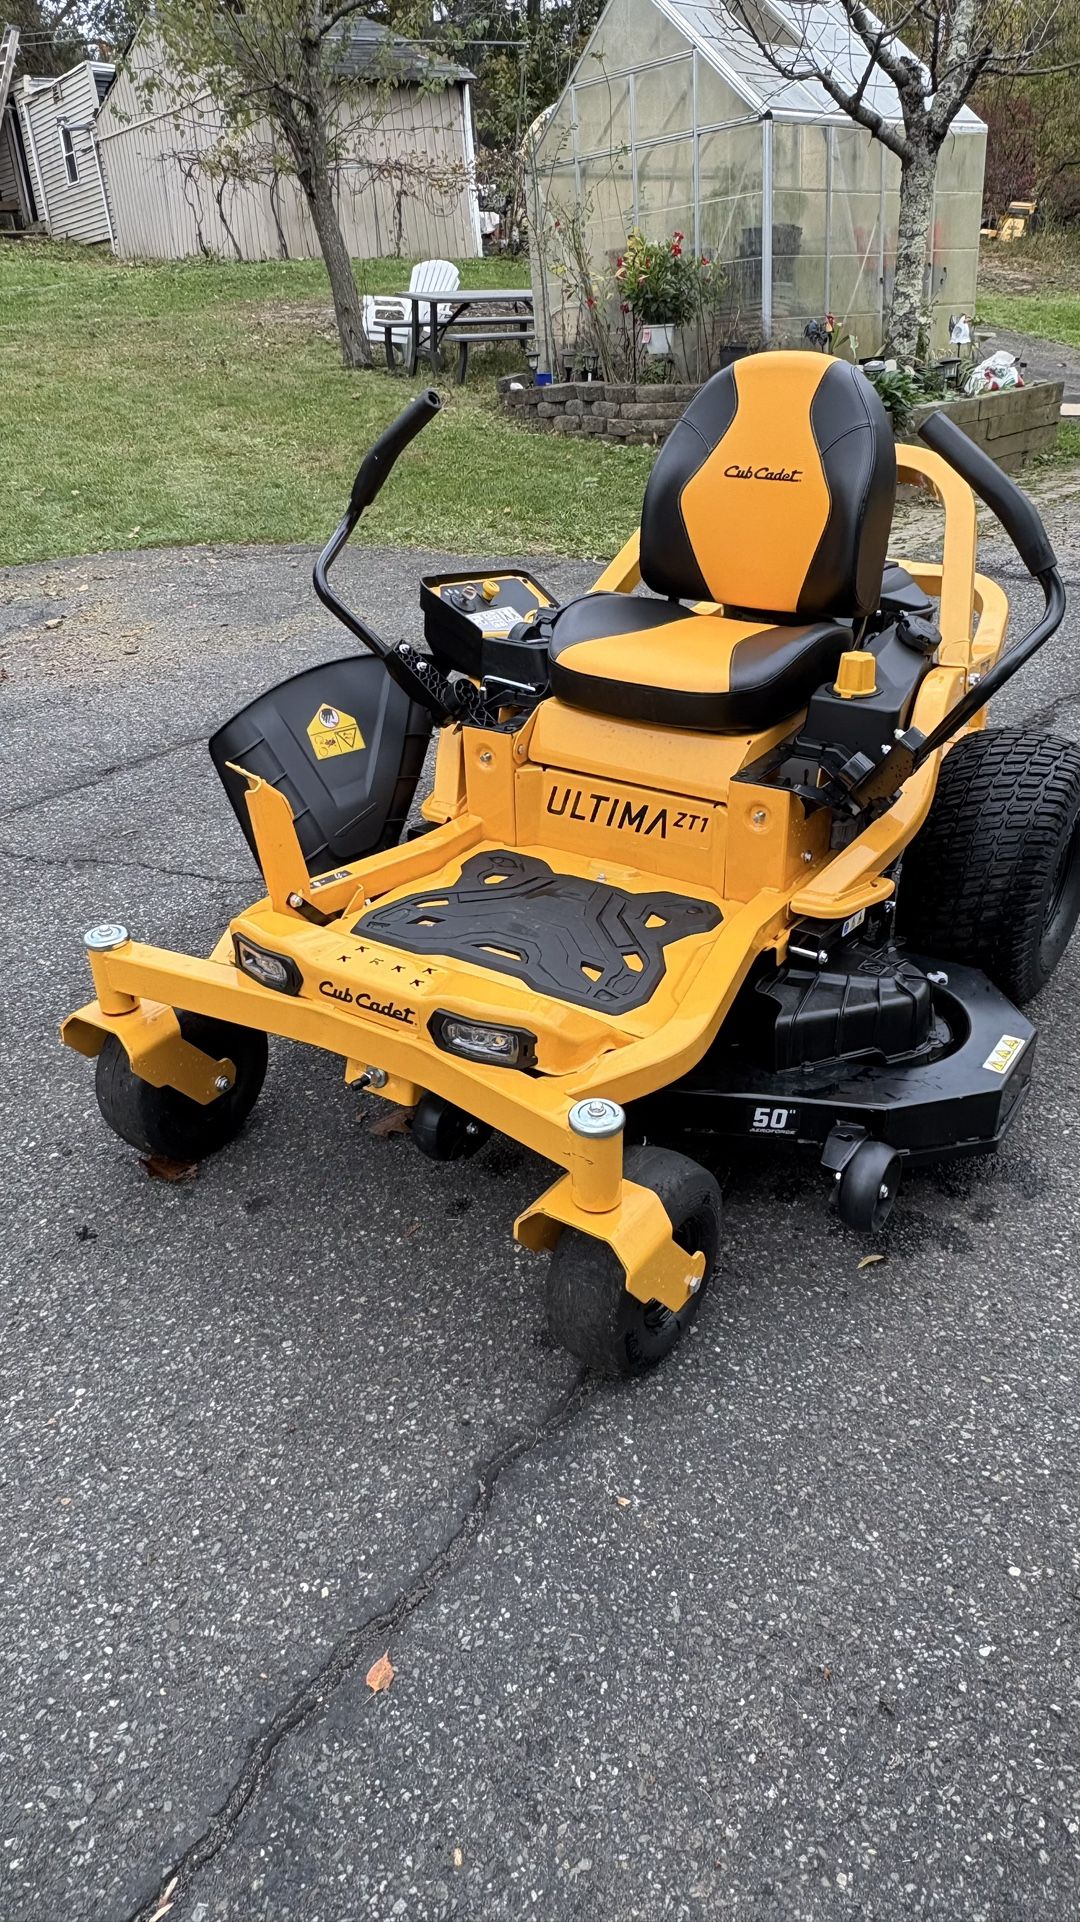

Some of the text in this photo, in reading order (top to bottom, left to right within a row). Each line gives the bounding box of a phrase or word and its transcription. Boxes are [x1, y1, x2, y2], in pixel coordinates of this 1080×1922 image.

[724, 465, 803, 482] Cub Cadet
[546, 786, 709, 839] ULTIMA ZT1
[319, 980, 415, 1024] Cub Cadet
[752, 1107, 796, 1128] 50"
